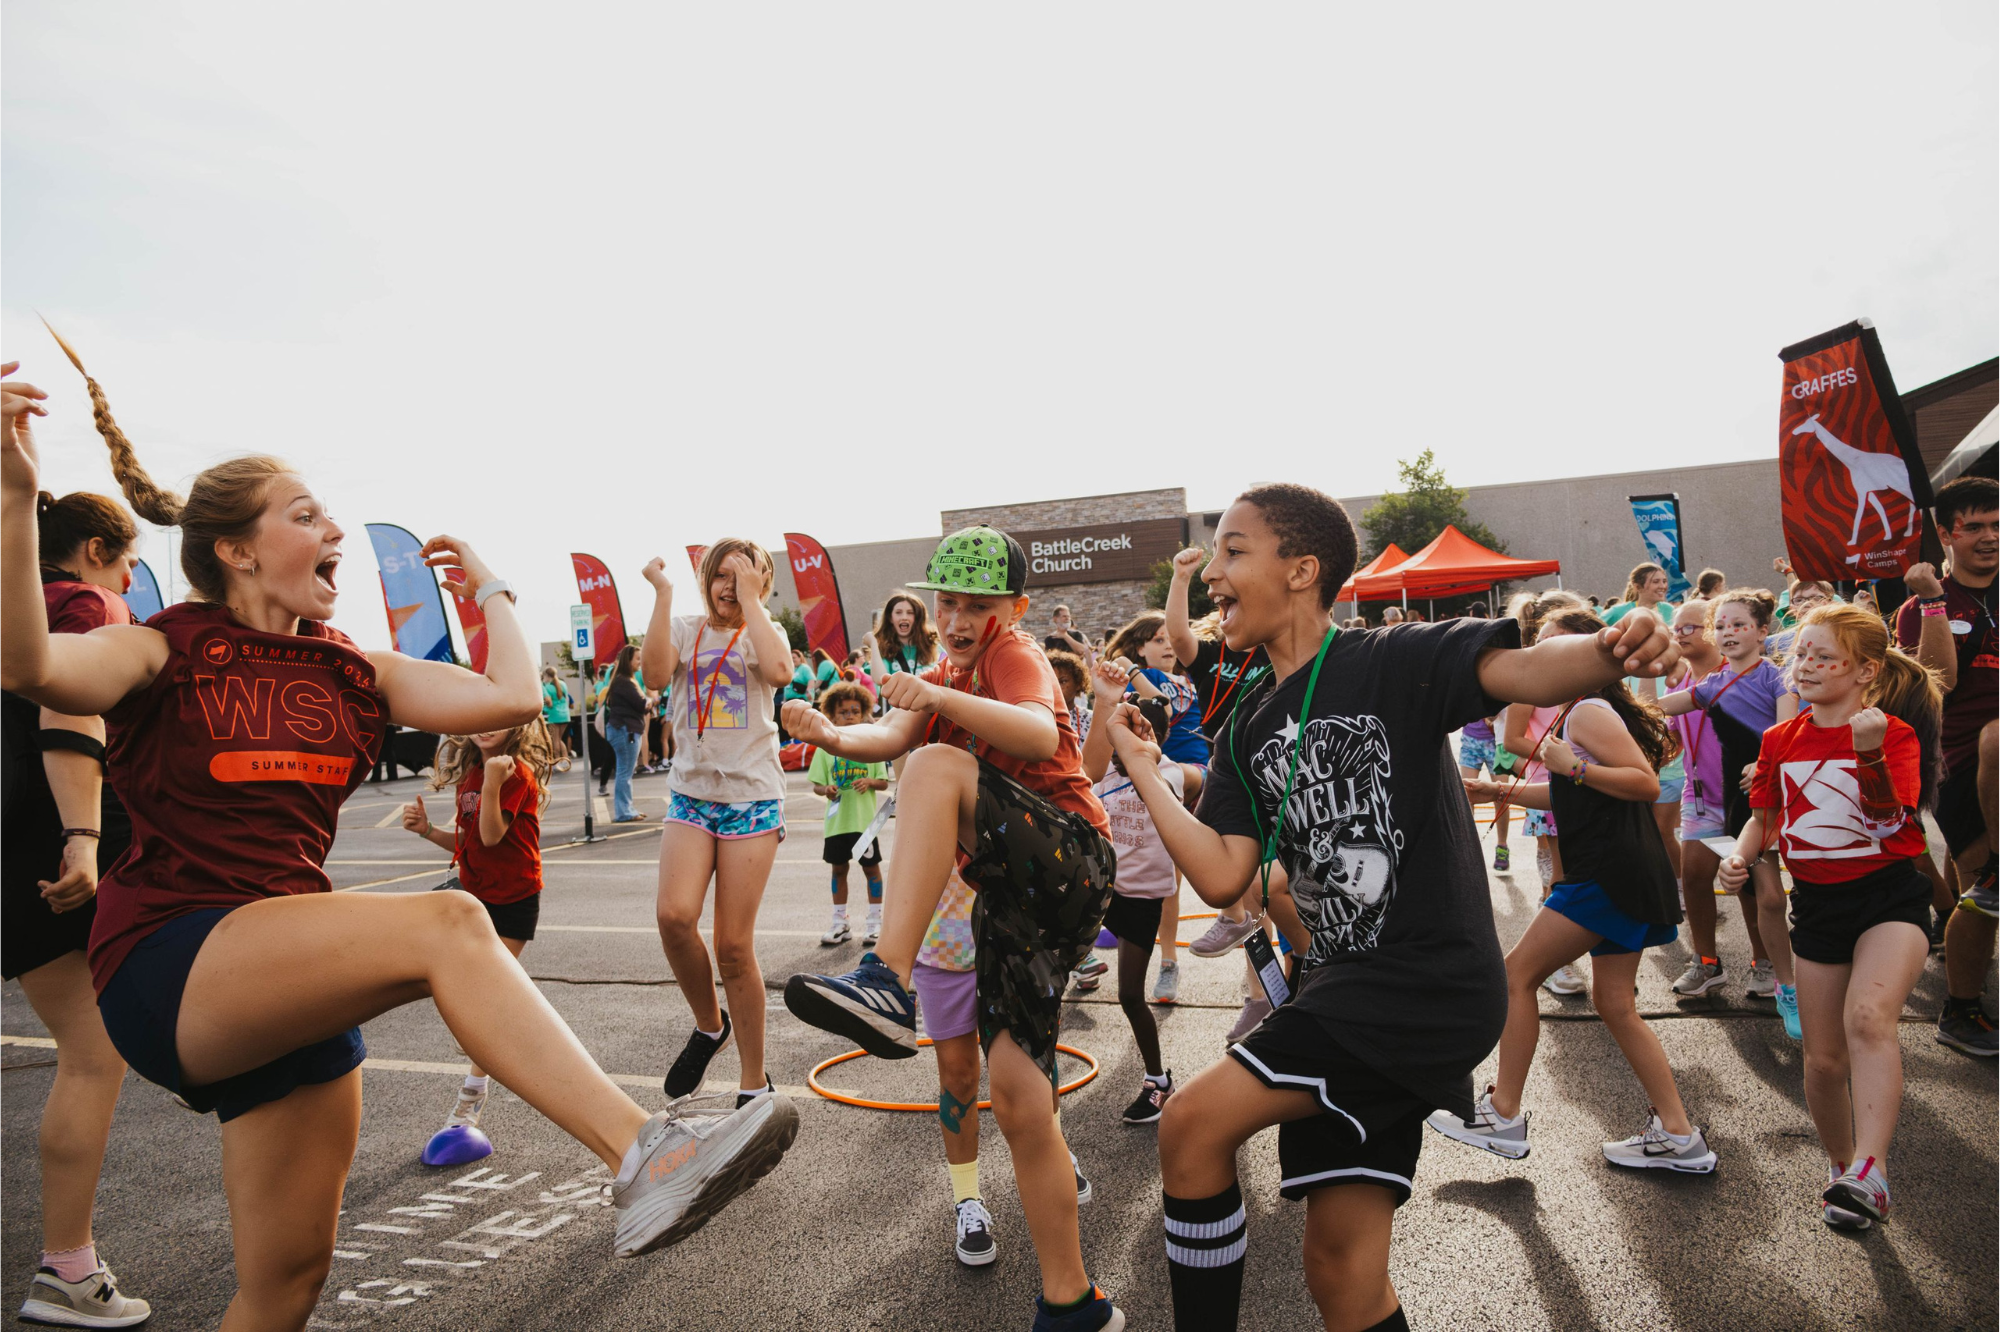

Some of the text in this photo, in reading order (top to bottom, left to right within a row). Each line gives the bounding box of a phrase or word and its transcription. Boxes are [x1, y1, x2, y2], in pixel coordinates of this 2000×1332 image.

[1031, 533, 1132, 557] BattleCreek
[383, 550, 418, 574] S-T
[794, 554, 823, 573] U-V
[941, 555, 986, 567] MINECRAFT
[1031, 554, 1092, 574] Church
[1867, 560, 1898, 568] Camps
[579, 574, 611, 592] M-N
[242, 644, 371, 687] SUMMER 2024
[252, 760, 308, 772] SUMMER
[1262, 739, 1333, 803] MAC
[1119, 799, 1145, 813] THE
[649, 1138, 697, 1183] HOKA
